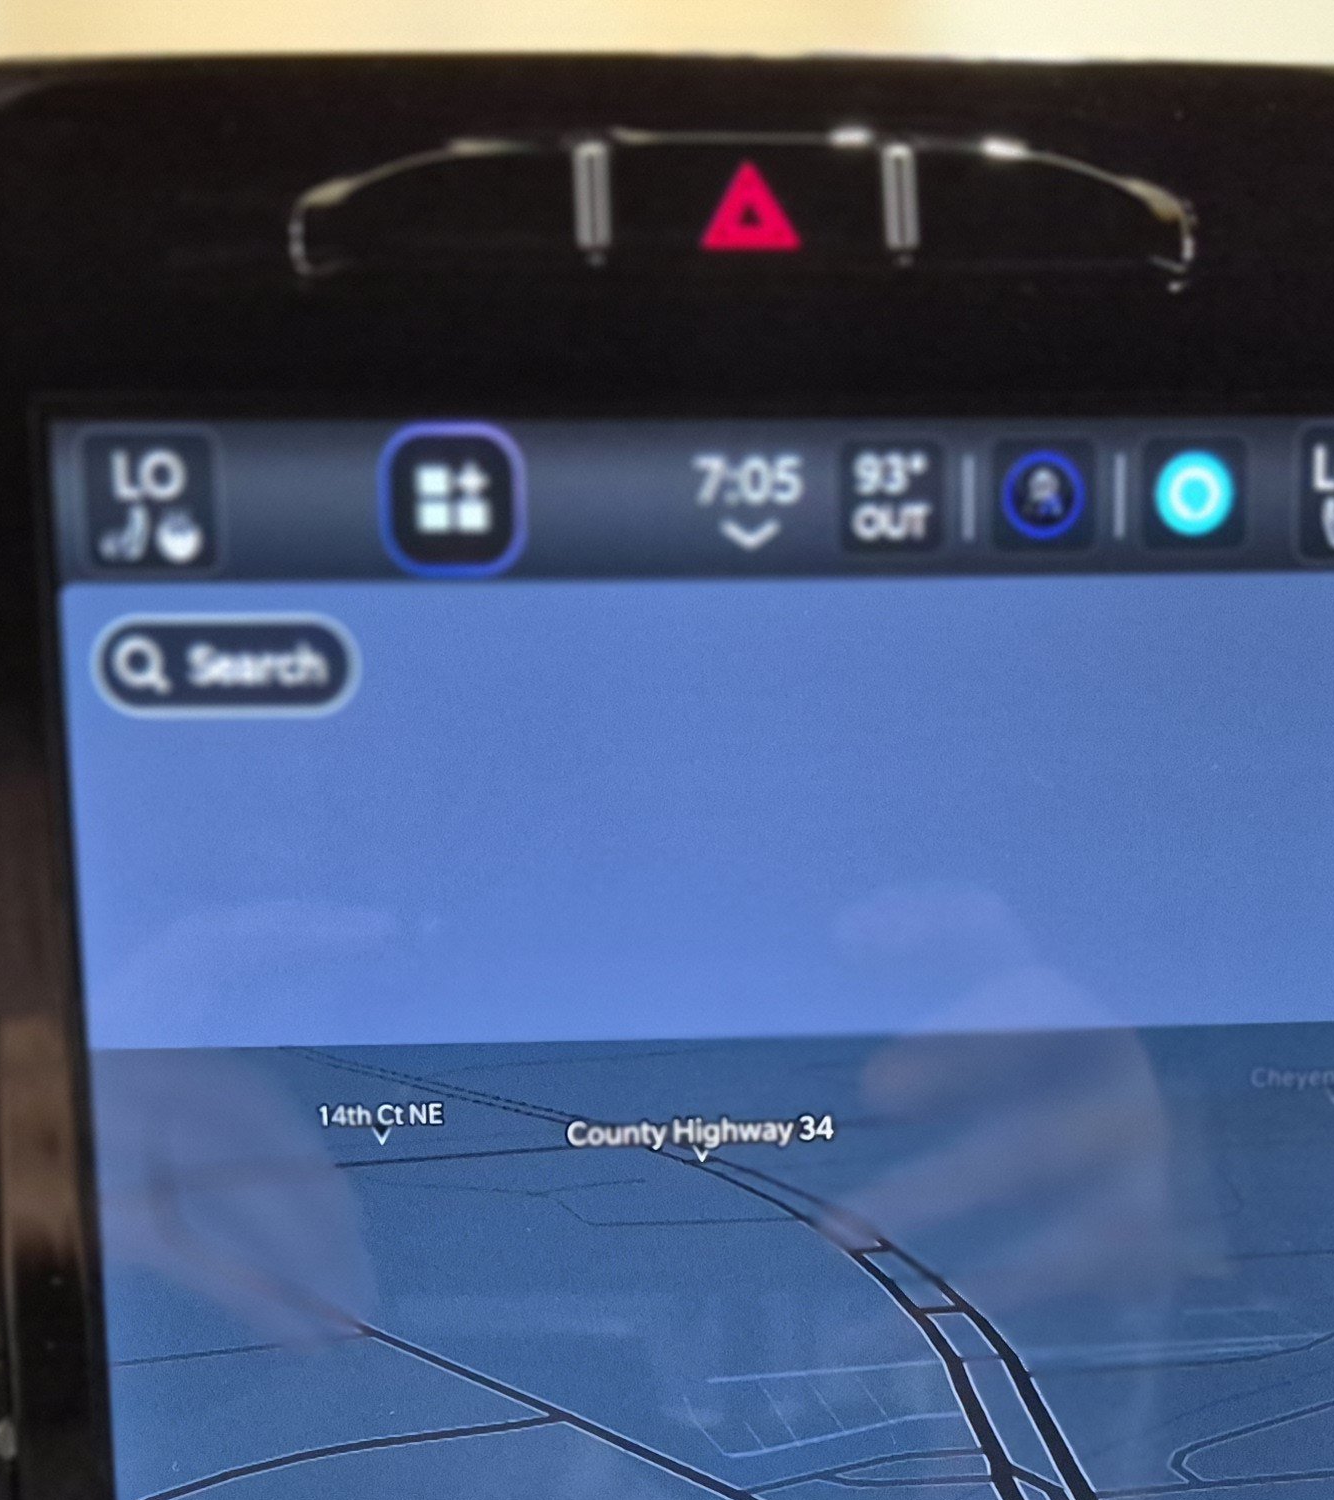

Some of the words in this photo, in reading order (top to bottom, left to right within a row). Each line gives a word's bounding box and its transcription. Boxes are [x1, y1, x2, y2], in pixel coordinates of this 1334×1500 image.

[110, 449, 186, 500] LO
[692, 453, 804, 505] 7:05
[852, 502, 931, 541] OUT
[187, 642, 329, 687] Search
[318, 1103, 372, 1127] 14th
[376, 1103, 405, 1126] Ct
[409, 1102, 444, 1125] NE
[567, 1120, 667, 1150] County
[672, 1116, 794, 1148] Highway
[798, 1115, 835, 1141] 34
